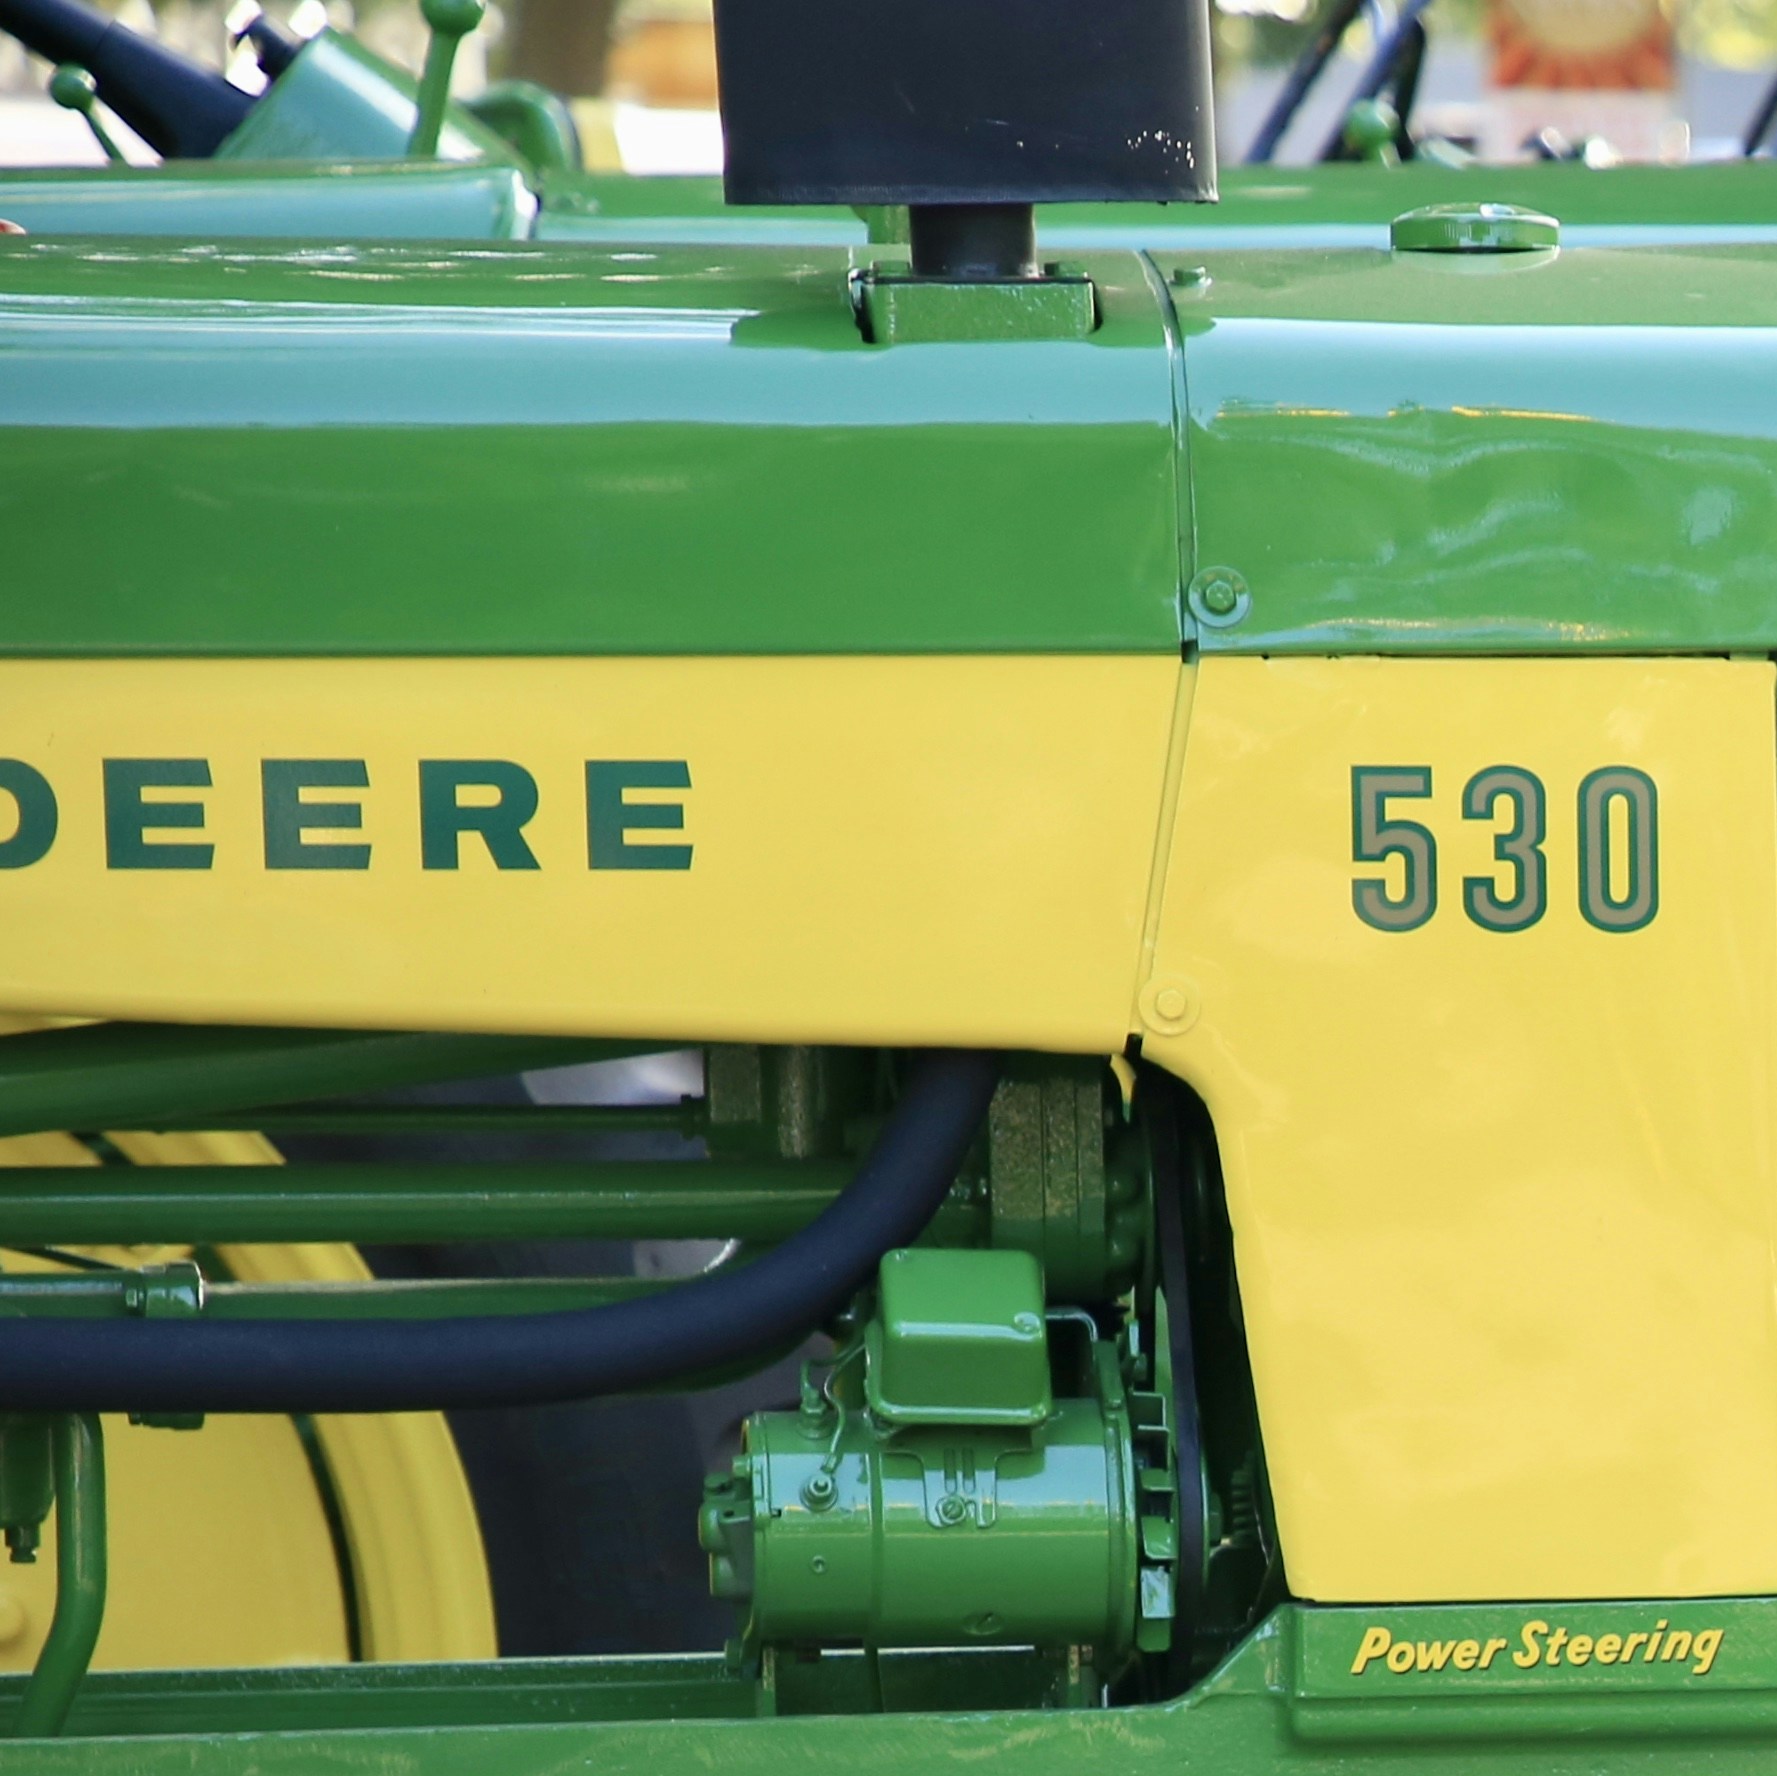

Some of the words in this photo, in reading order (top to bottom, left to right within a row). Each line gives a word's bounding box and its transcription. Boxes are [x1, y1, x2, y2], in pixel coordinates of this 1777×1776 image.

[1350, 764, 1659, 932] 530
[1350, 1627, 1508, 1674] Power
[1512, 1618, 1725, 1675] Steering
